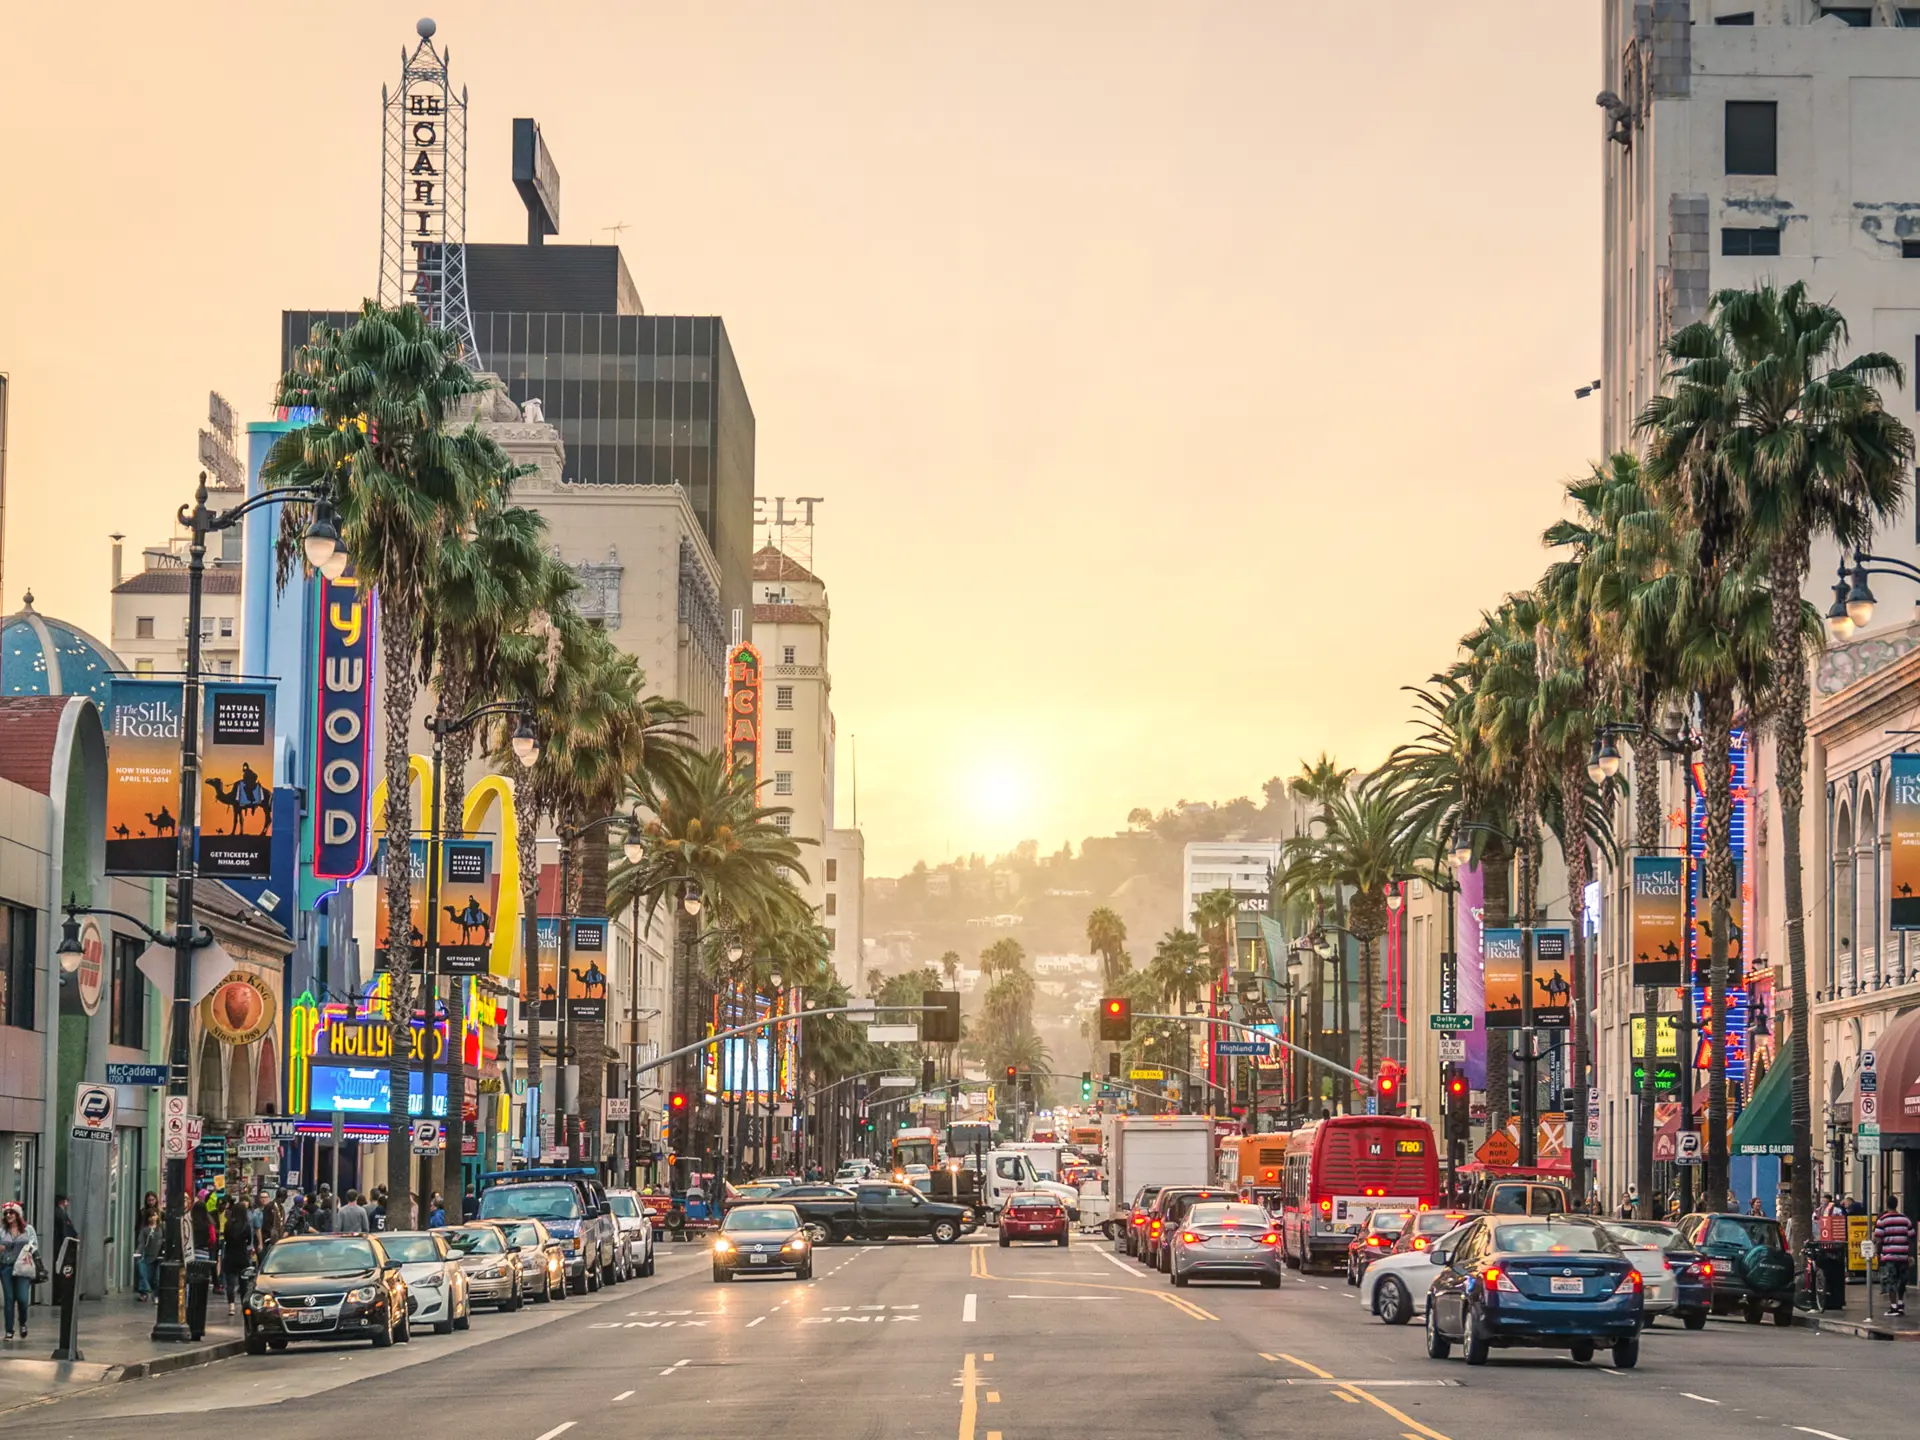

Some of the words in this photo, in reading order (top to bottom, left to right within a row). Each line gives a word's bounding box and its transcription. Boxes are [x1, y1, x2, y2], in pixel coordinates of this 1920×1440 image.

[732, 662, 758, 687] EL
[122, 704, 137, 715] The
[137, 701, 173, 722] Silk
[219, 704, 260, 712] NATURAL
[219, 712, 260, 720] HISTORY
[121, 715, 179, 739] Road
[219, 720, 260, 728] MUSEUM
[115, 766, 135, 775] NOW
[135, 767, 172, 776] THROUGH
[119, 775, 141, 783] APRIL
[153, 776, 169, 784] 2014
[1901, 775, 1916, 785] The
[1651, 870, 1675, 885] Silk
[1641, 880, 1679, 896] Road
[538, 935, 557, 948] oad
[1498, 939, 1518, 951] Silk
[1490, 946, 1520, 959] Road
[247, 975, 270, 1000] KING
[1436, 1015, 1457, 1023] Dolby
[1433, 1022, 1461, 1030] Theatre
[212, 1026, 236, 1043] Since
[240, 1027, 260, 1043] 1989
[1220, 1044, 1253, 1053] Highland
[1255, 1044, 1266, 1052] Av
[108, 1065, 157, 1076] McCadden
[74, 1129, 88, 1138] PAY
[91, 1131, 111, 1140] HERE
[246, 1124, 270, 1137] ATM
[239, 1144, 276, 1152] INTERNET
[1399, 1141, 1420, 1152] 780
[1741, 1144, 1767, 1154] CAMERAS
[377, 1218, 385, 1230] 5
